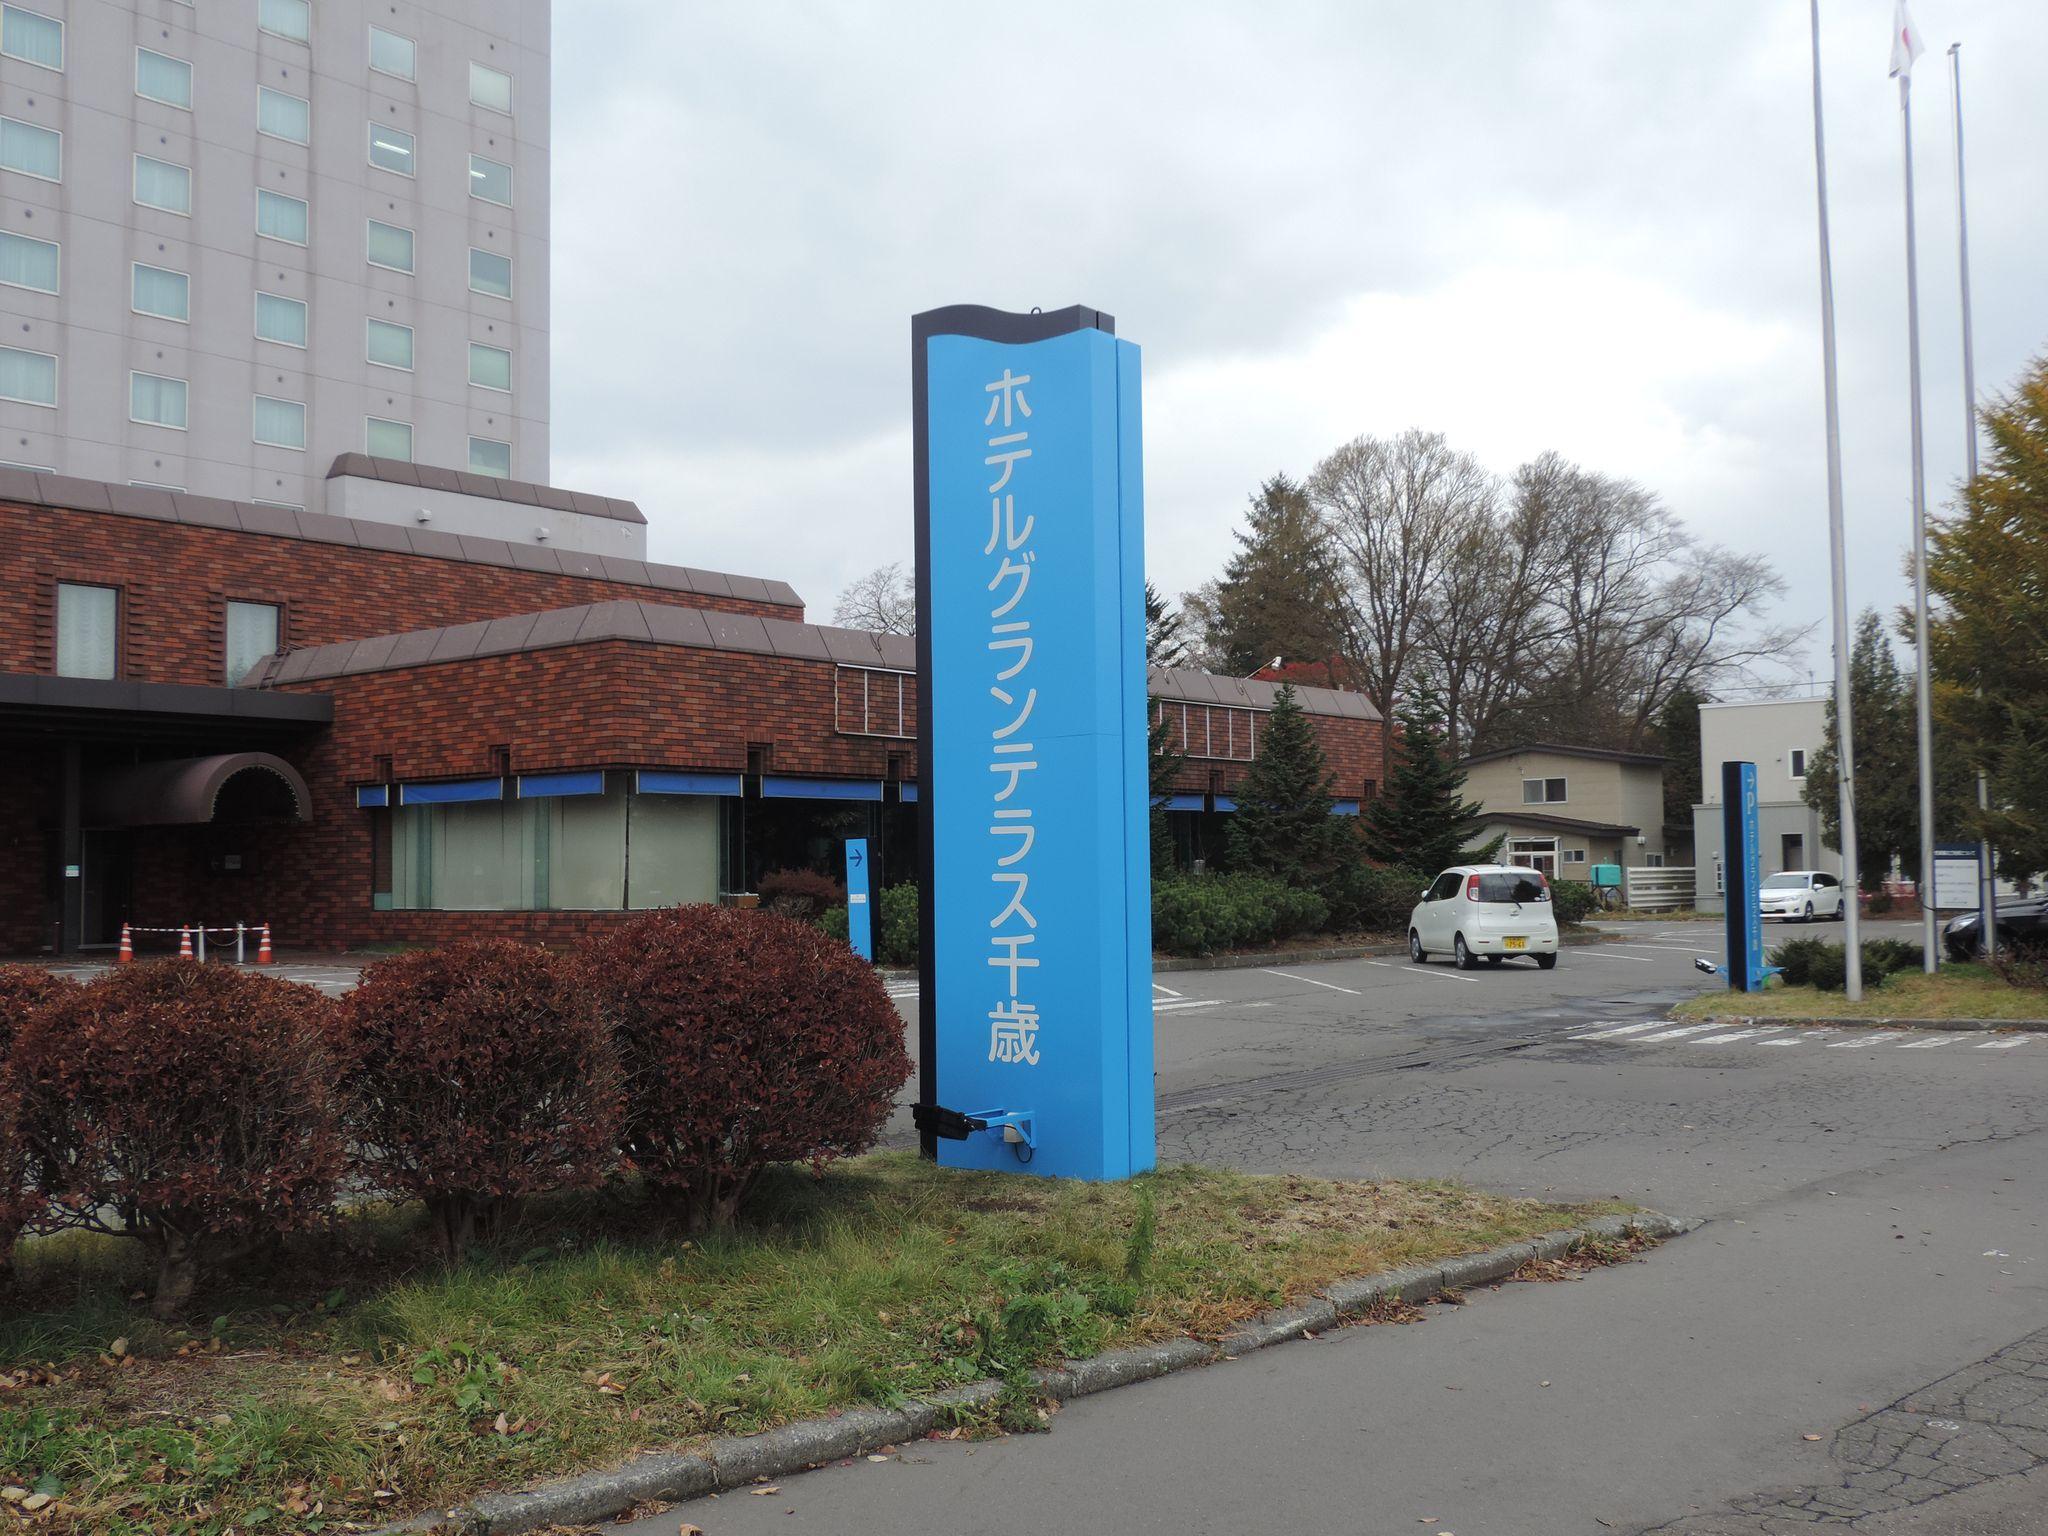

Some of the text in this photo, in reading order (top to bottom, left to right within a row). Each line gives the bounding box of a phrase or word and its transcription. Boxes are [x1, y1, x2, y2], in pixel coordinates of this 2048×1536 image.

[984, 368, 1040, 1066] ホテルグランテラス千歳
